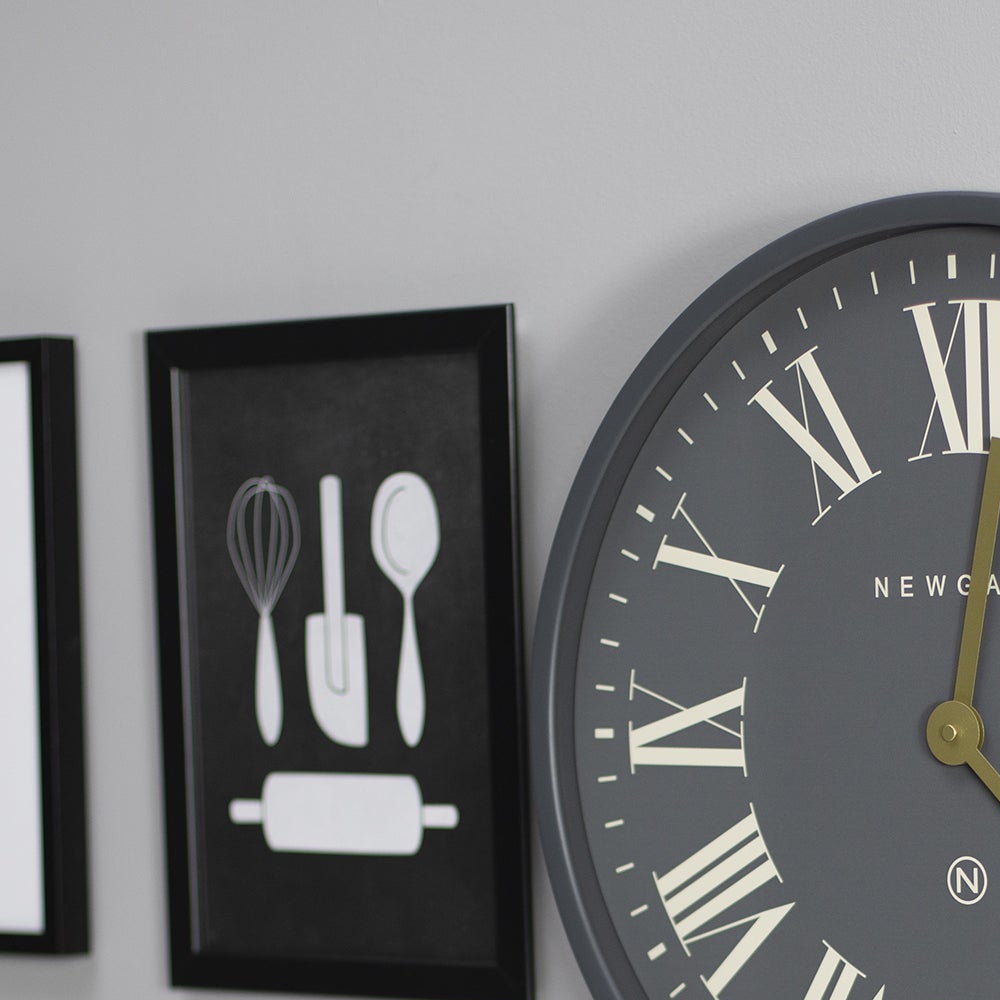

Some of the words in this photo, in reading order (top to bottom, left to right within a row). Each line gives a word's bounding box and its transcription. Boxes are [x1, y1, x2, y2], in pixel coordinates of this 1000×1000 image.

[747, 346, 882, 525] XI
[653, 493, 784, 632] X
[629, 670, 748, 776] IX
